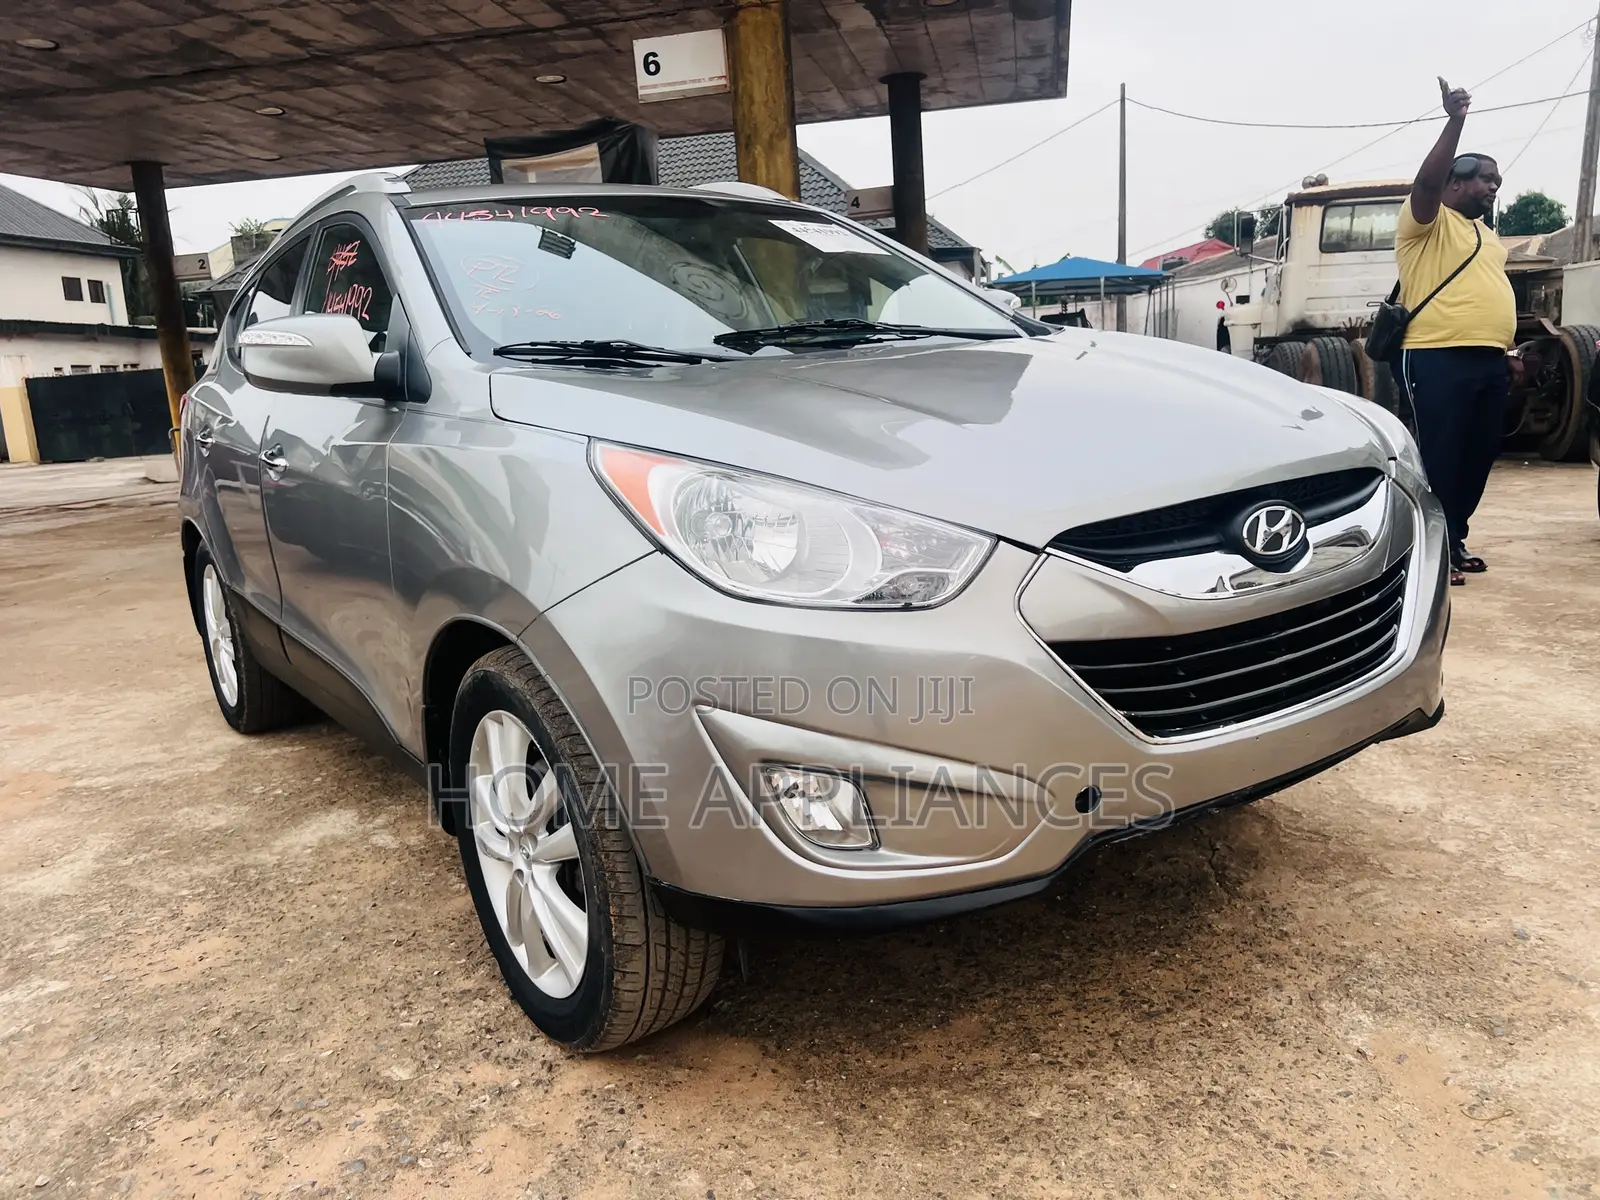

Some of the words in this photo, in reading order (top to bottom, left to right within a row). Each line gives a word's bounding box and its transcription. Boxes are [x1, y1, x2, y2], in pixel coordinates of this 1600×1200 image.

[643, 51, 661, 76] 6
[850, 196, 861, 208] 4
[198, 259, 207, 270] 2
